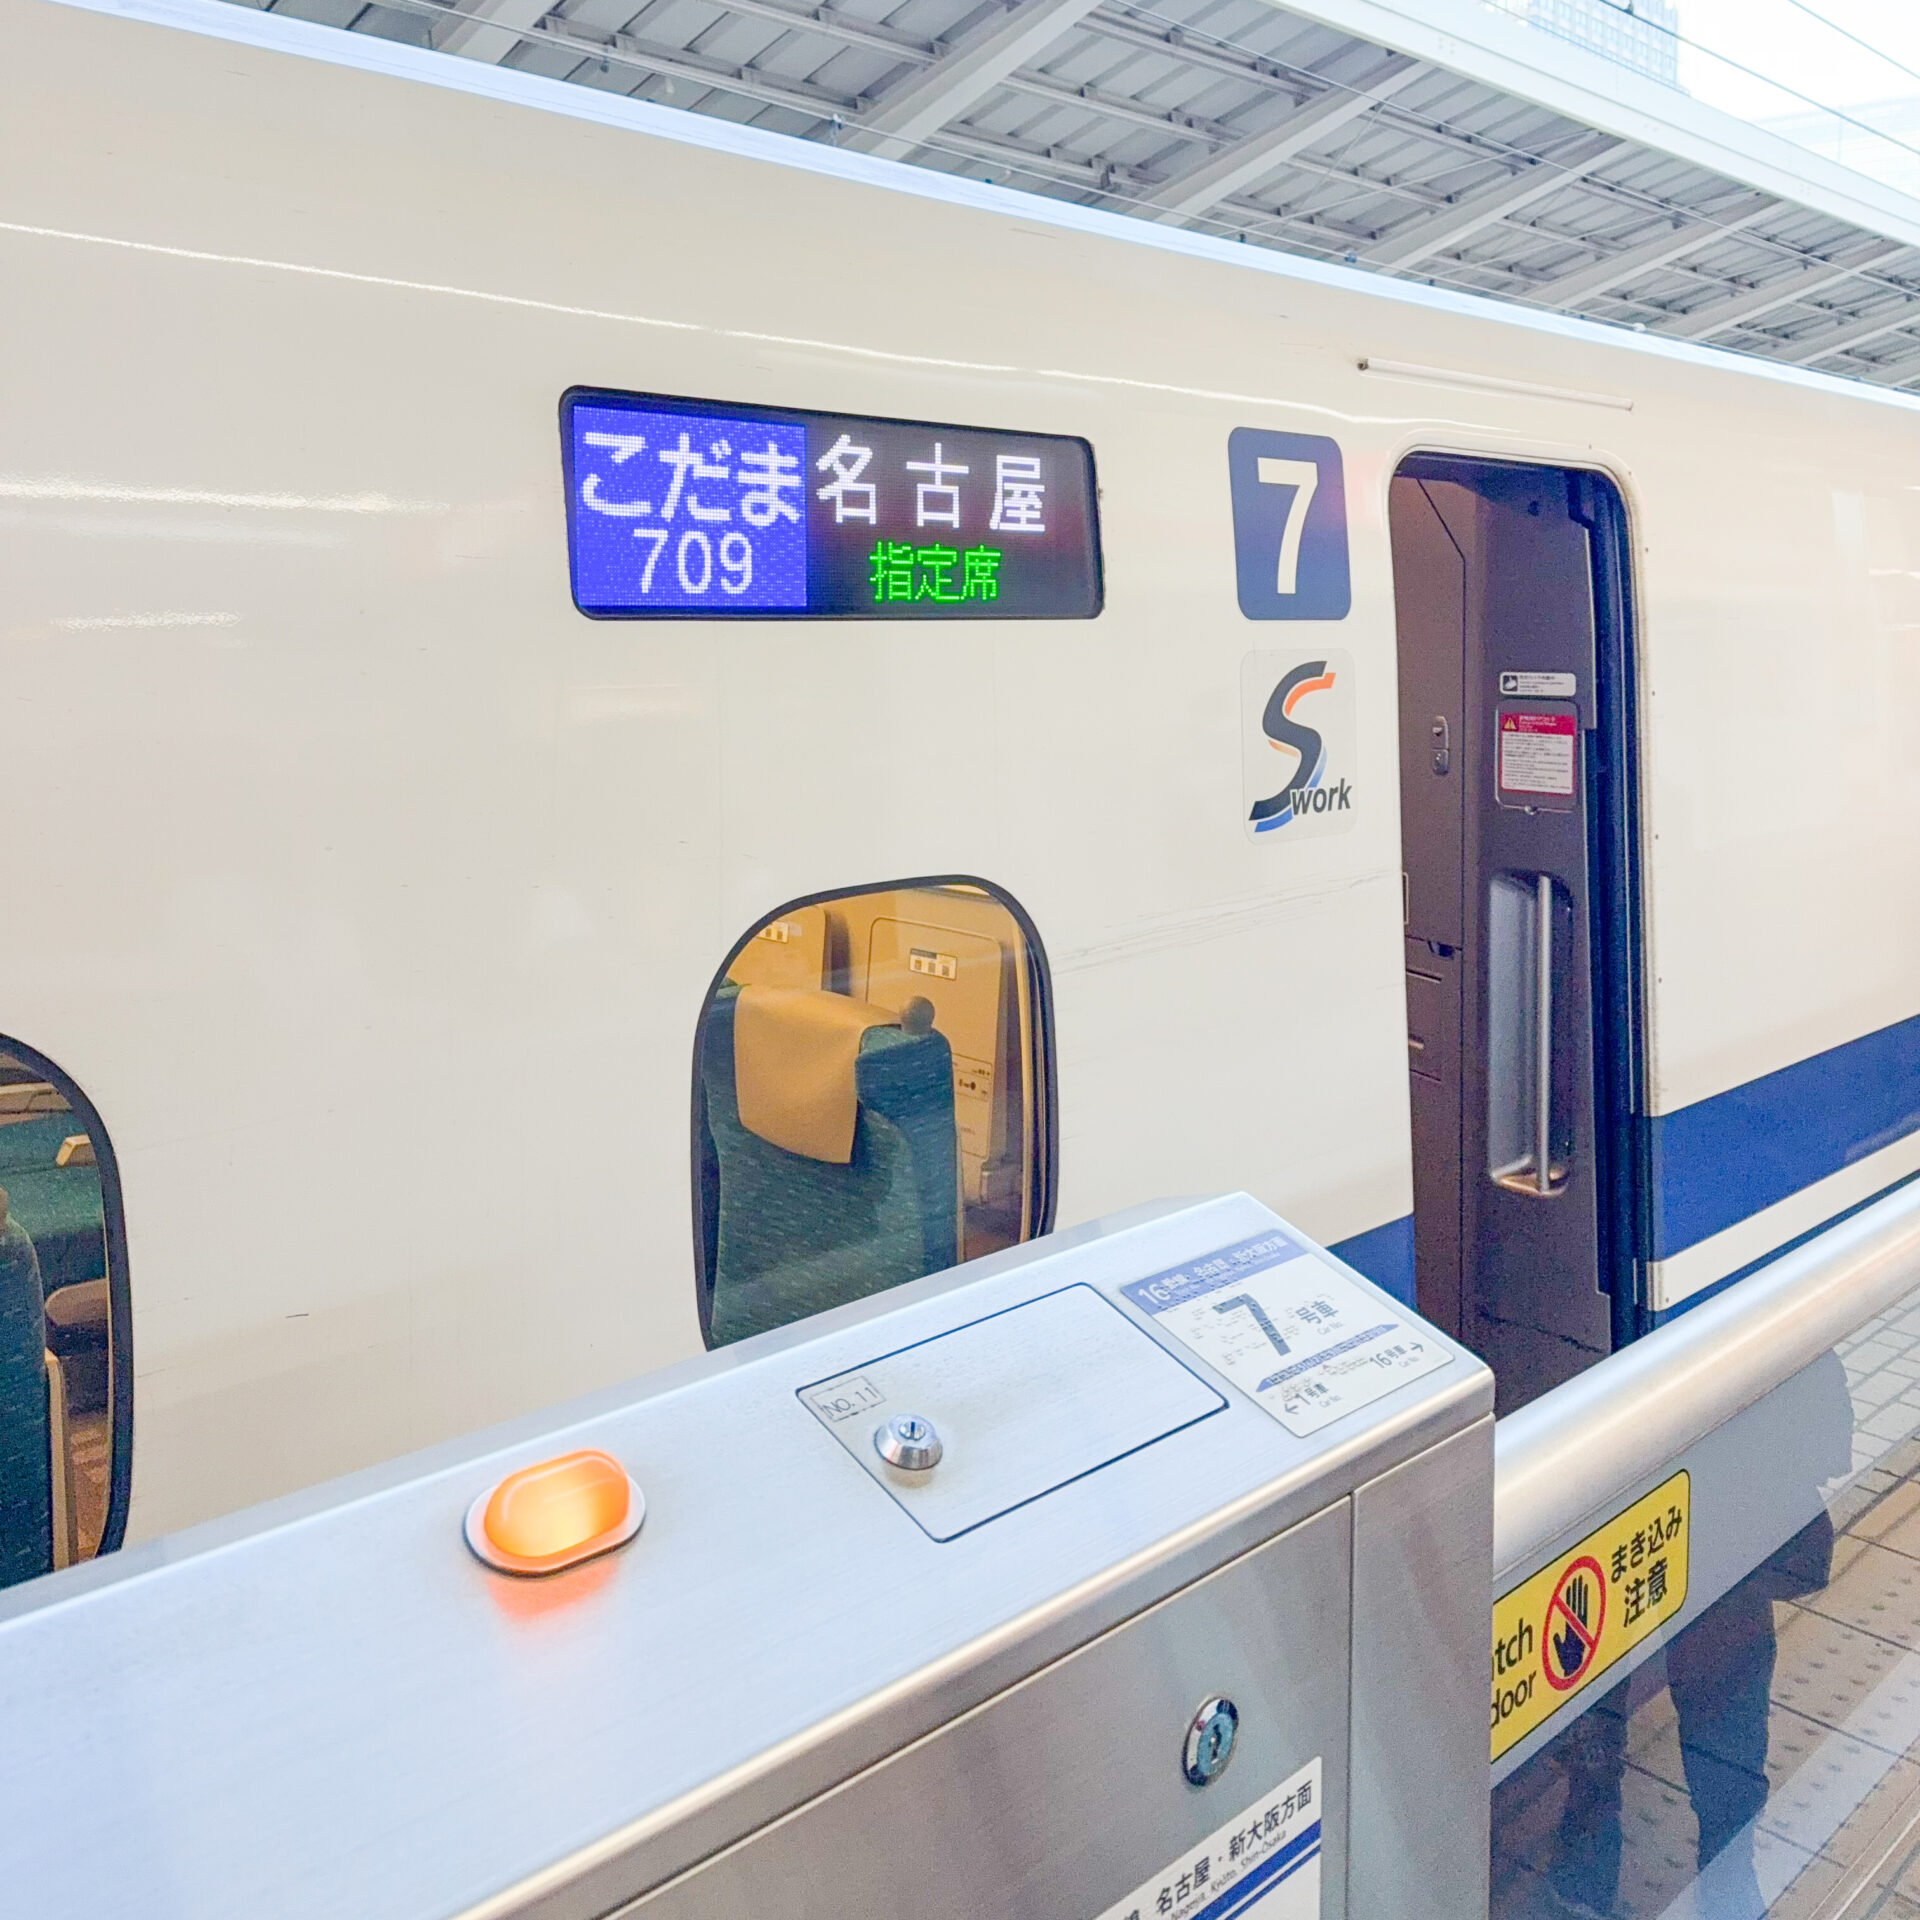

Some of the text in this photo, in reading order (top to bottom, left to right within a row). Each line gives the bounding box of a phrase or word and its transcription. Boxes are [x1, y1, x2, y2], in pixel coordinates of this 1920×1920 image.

[582, 431, 803, 526] こだま
[816, 434, 1045, 532] 名古屋
[1257, 457, 1318, 594] 7
[633, 529, 753, 594] 709
[868, 540, 1002, 602] 指定席
[1290, 777, 1351, 816] work
[1212, 1293, 1291, 1356] 7
[1295, 1300, 1339, 1325] 号車
[1611, 1506, 1682, 1583] まき込み
[1623, 1557, 1668, 1628] 注意
[1491, 1617, 1533, 1682] tch
[1491, 1670, 1537, 1729] door
